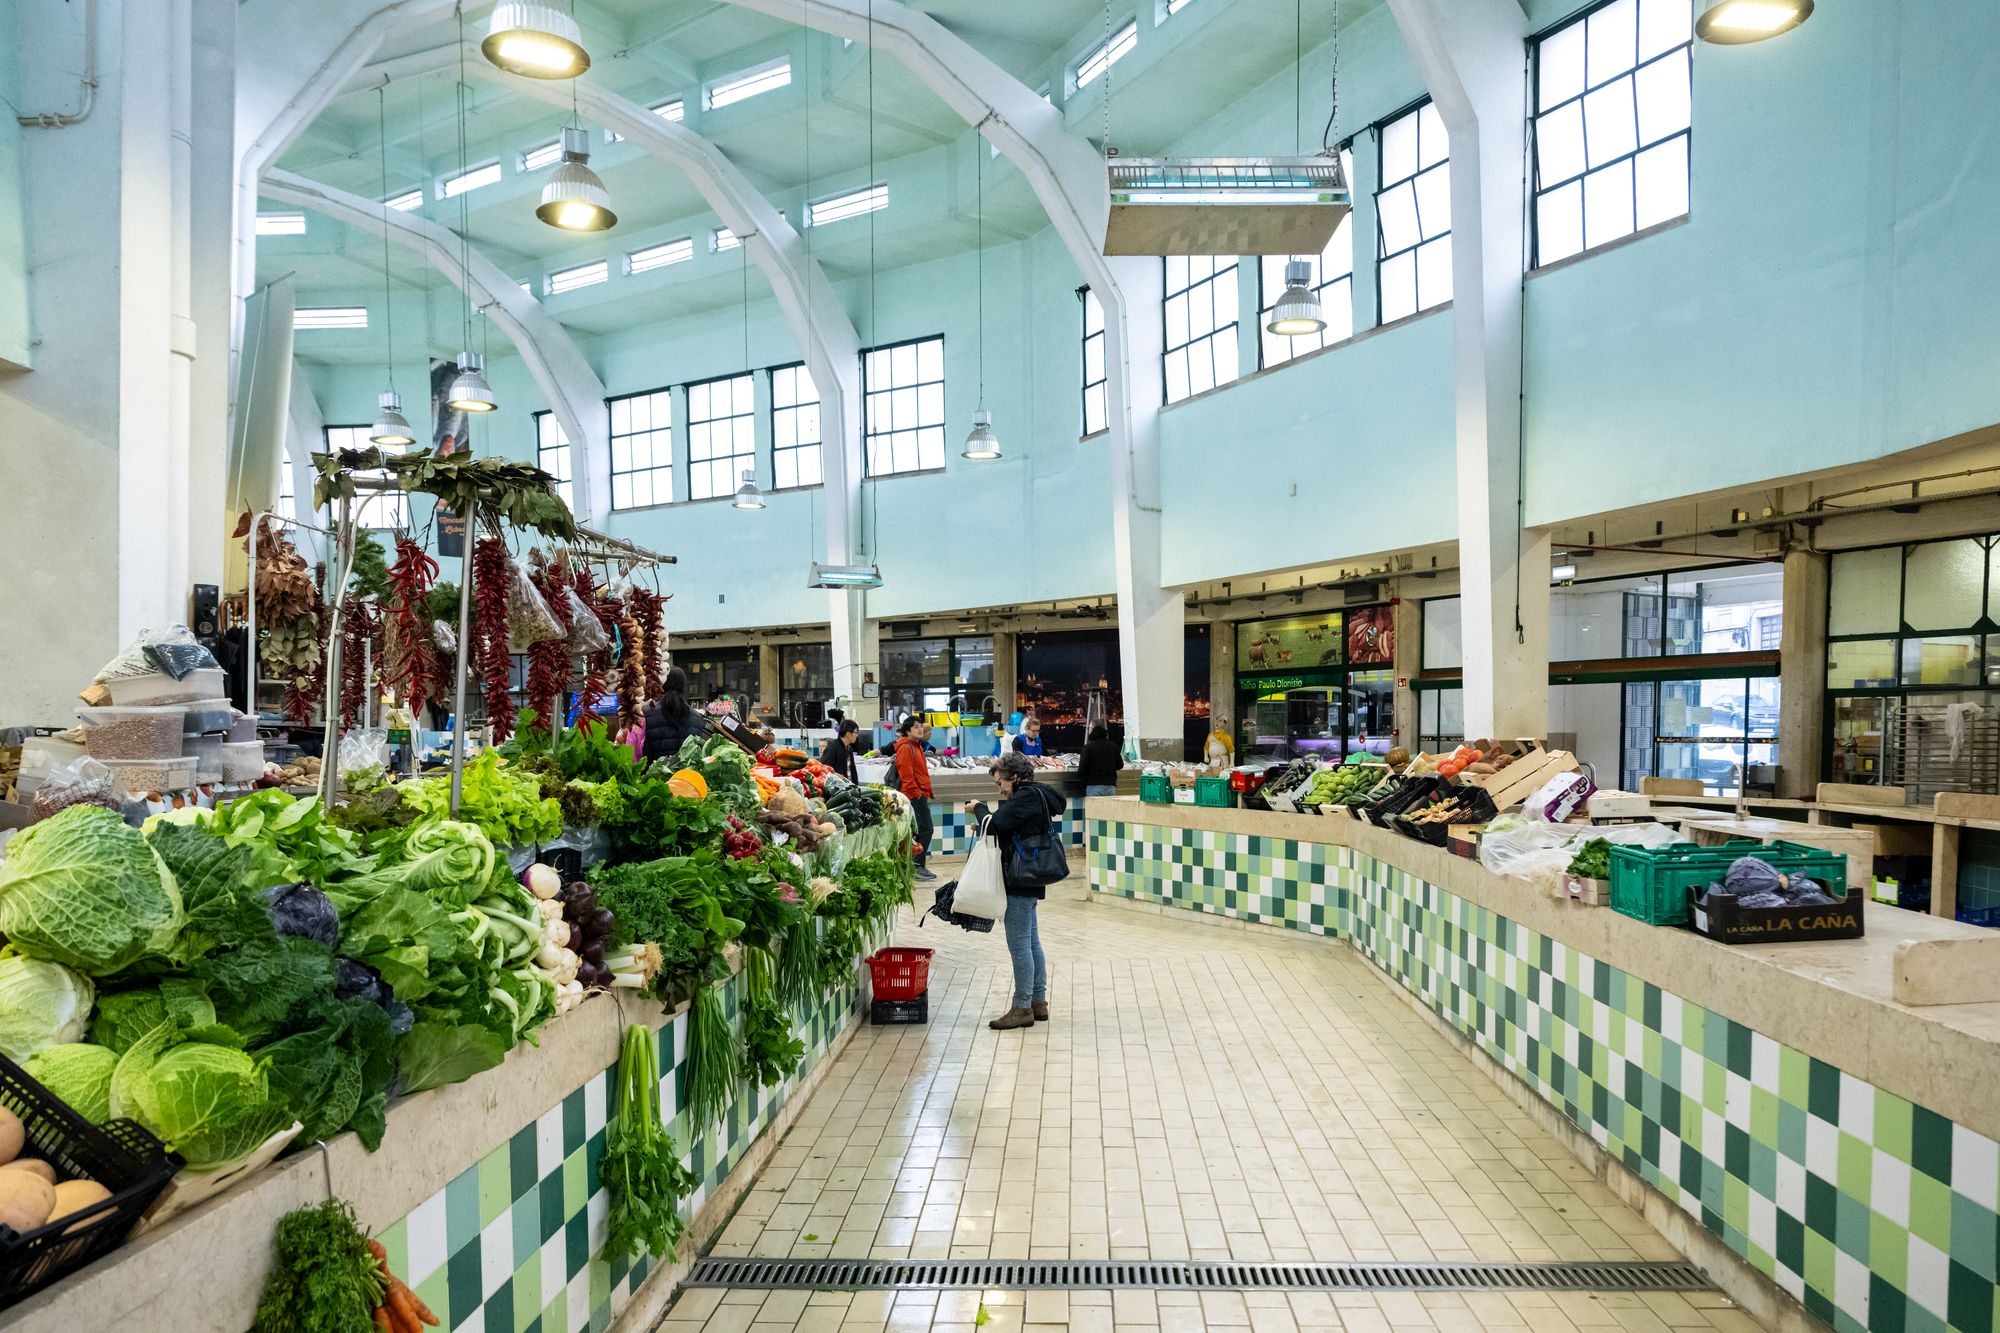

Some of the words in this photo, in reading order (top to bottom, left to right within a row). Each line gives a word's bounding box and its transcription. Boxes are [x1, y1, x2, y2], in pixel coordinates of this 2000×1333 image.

[1258, 680, 1275, 689] Paulo
[1766, 919, 1793, 931] LA
[1799, 913, 1858, 929] CAÑA
